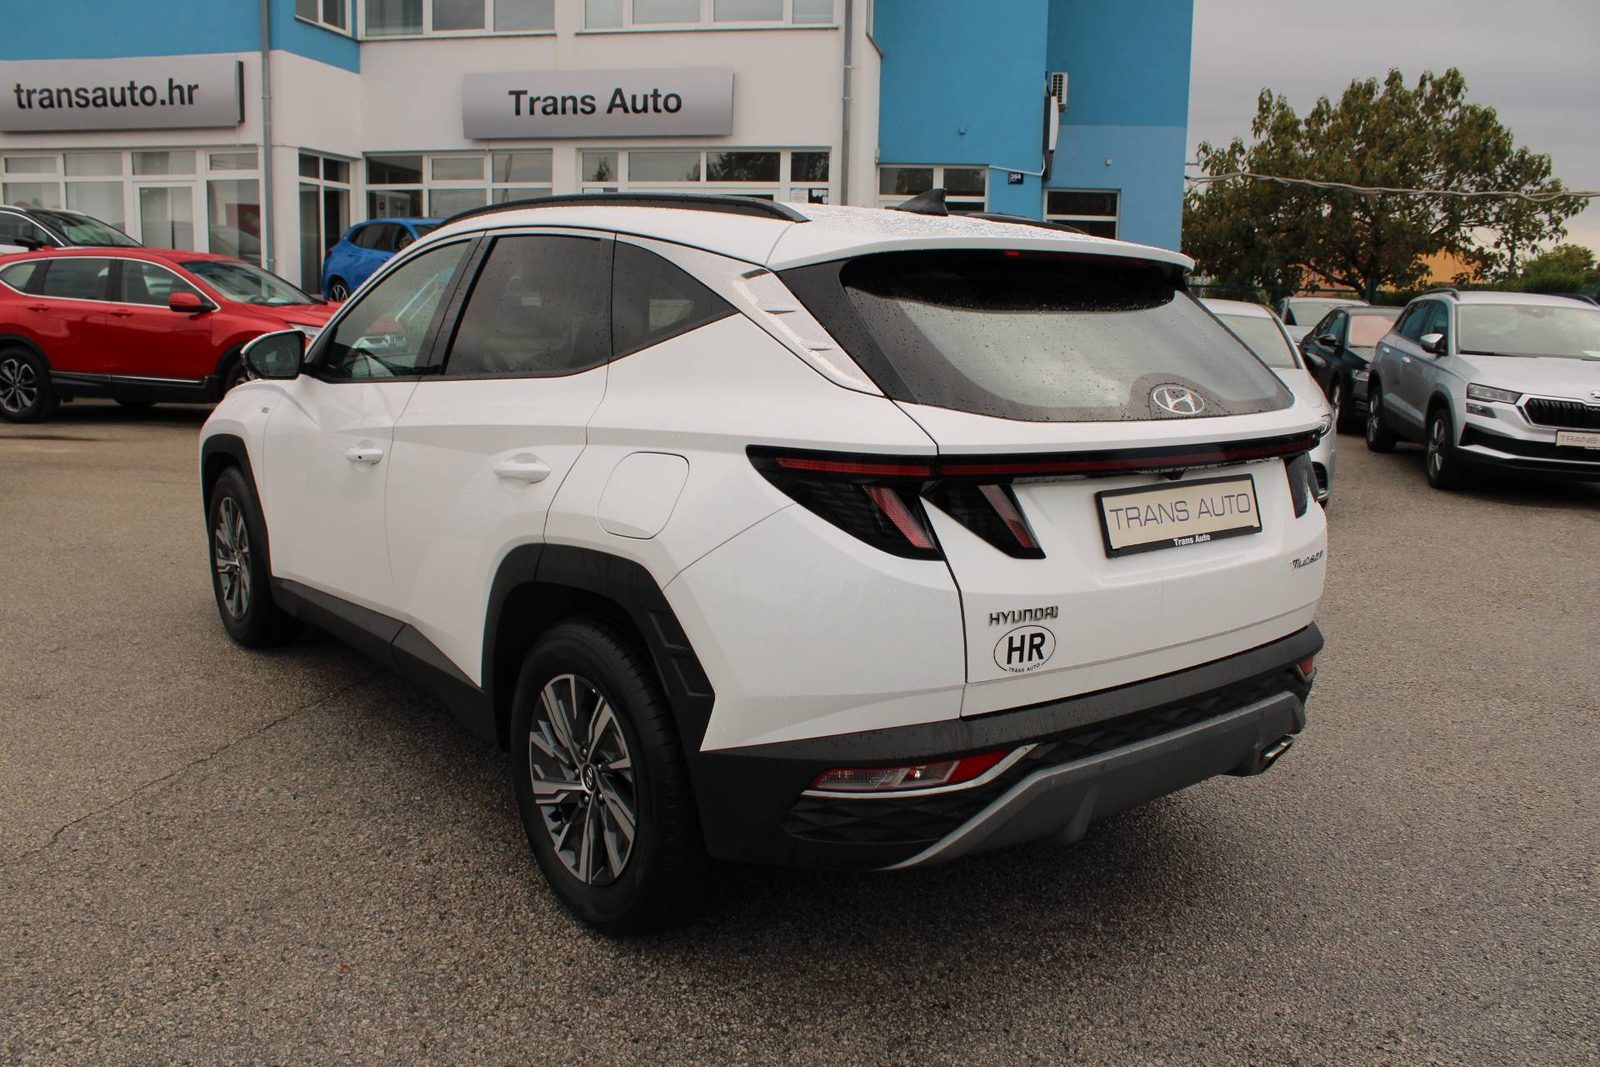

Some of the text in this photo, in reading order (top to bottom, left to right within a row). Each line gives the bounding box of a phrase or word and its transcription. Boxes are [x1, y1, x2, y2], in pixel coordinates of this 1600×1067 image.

[14, 77, 199, 109] transauto.hr
[508, 87, 682, 116] Trans Auto
[1560, 435, 1597, 444] TRANS
[1109, 493, 1251, 530] TRANS AUTO
[1173, 533, 1211, 547] Trans Auto
[988, 605, 1059, 626] HYUNDAI
[1006, 632, 1046, 665] HR
[1026, 662, 1041, 672] AUTO
